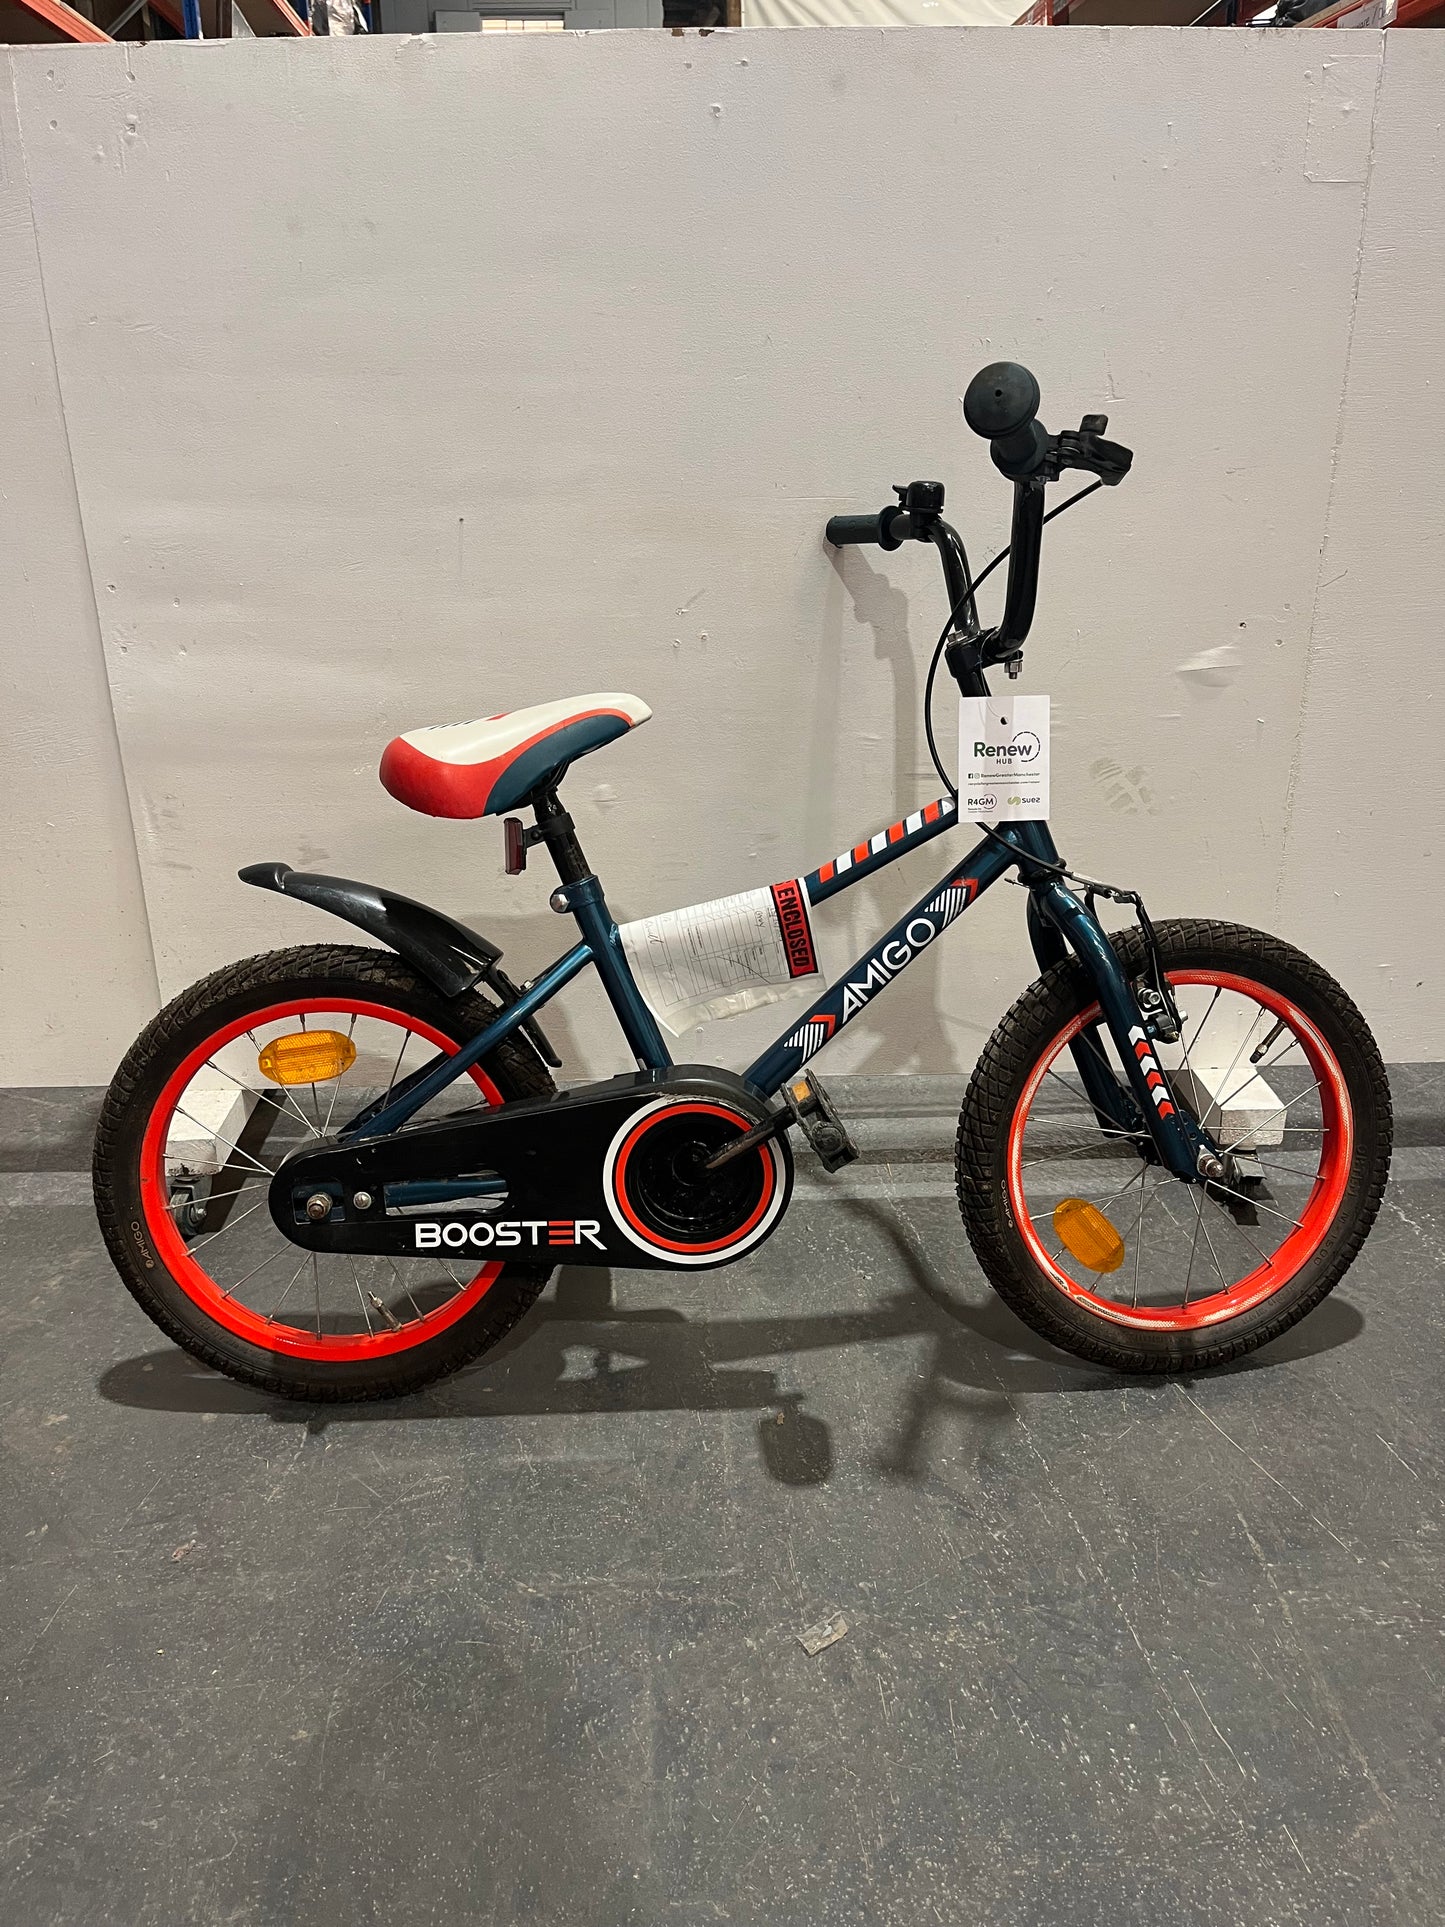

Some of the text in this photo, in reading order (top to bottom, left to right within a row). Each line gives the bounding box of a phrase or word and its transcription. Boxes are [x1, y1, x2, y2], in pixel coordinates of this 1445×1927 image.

[974, 741, 1032, 757] Renew
[967, 798, 994, 806] R4GM
[777, 888, 810, 967] ENCLOSED
[842, 917, 936, 1024] AMIGO
[130, 1221, 152, 1260] AMIGO
[415, 1219, 608, 1250] BOOSTER
